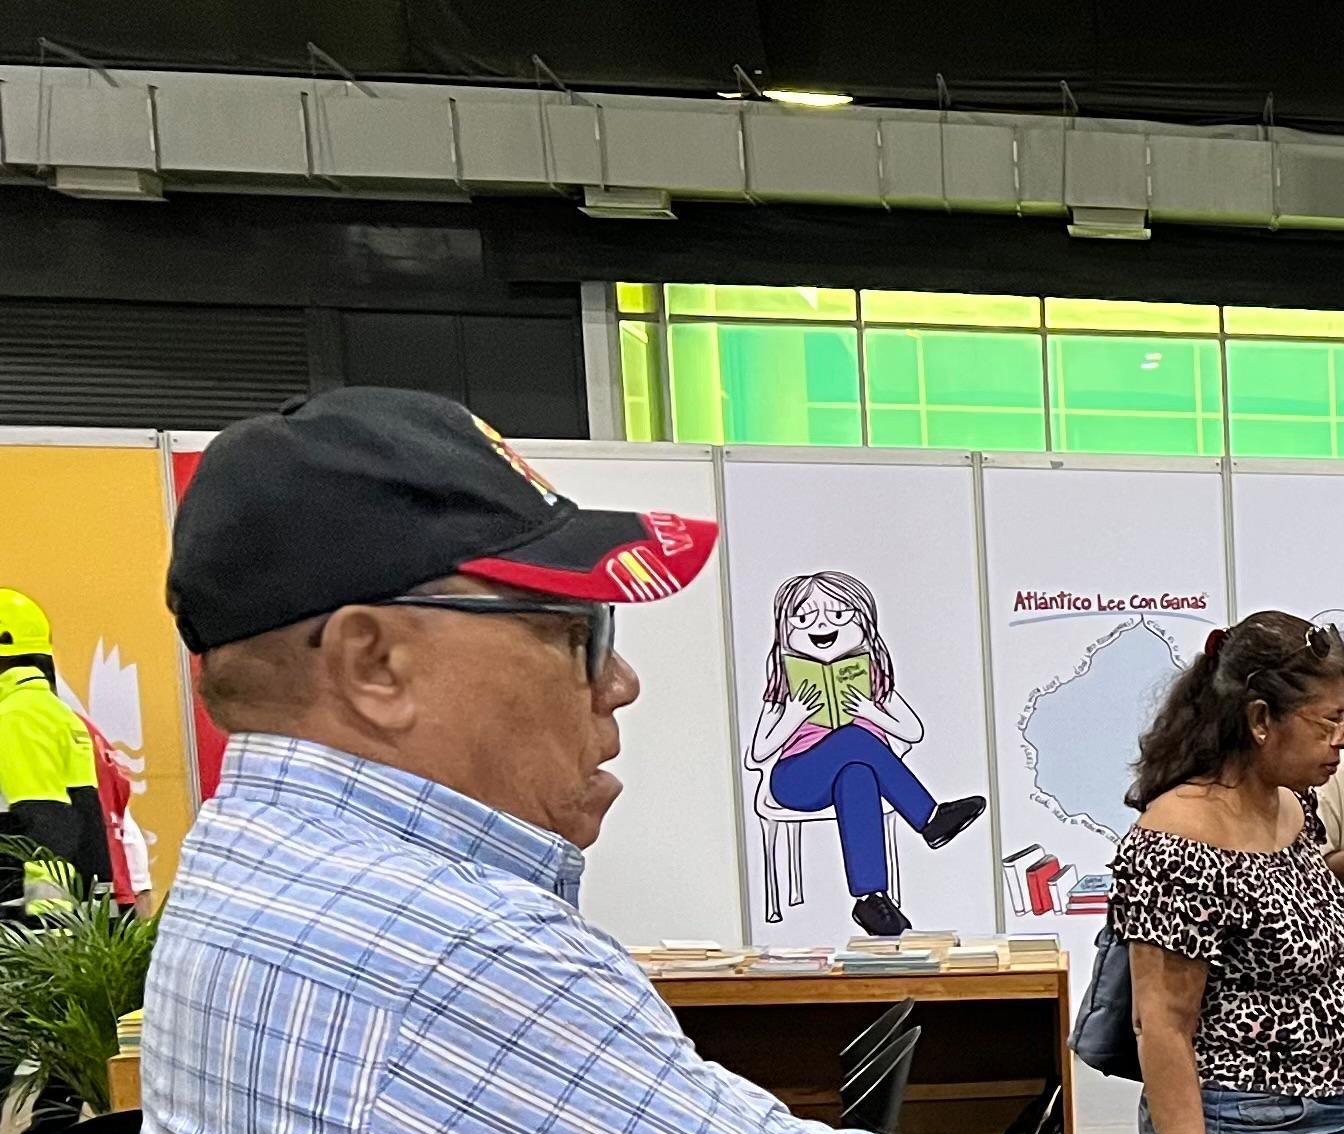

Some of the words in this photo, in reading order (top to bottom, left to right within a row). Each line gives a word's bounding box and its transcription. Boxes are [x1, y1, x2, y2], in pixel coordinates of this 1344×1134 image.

[1014, 591, 1091, 612] Atlántico
[1098, 594, 1125, 611] Lee
[1130, 594, 1157, 609] Con
[1160, 593, 1206, 610] Ganas
